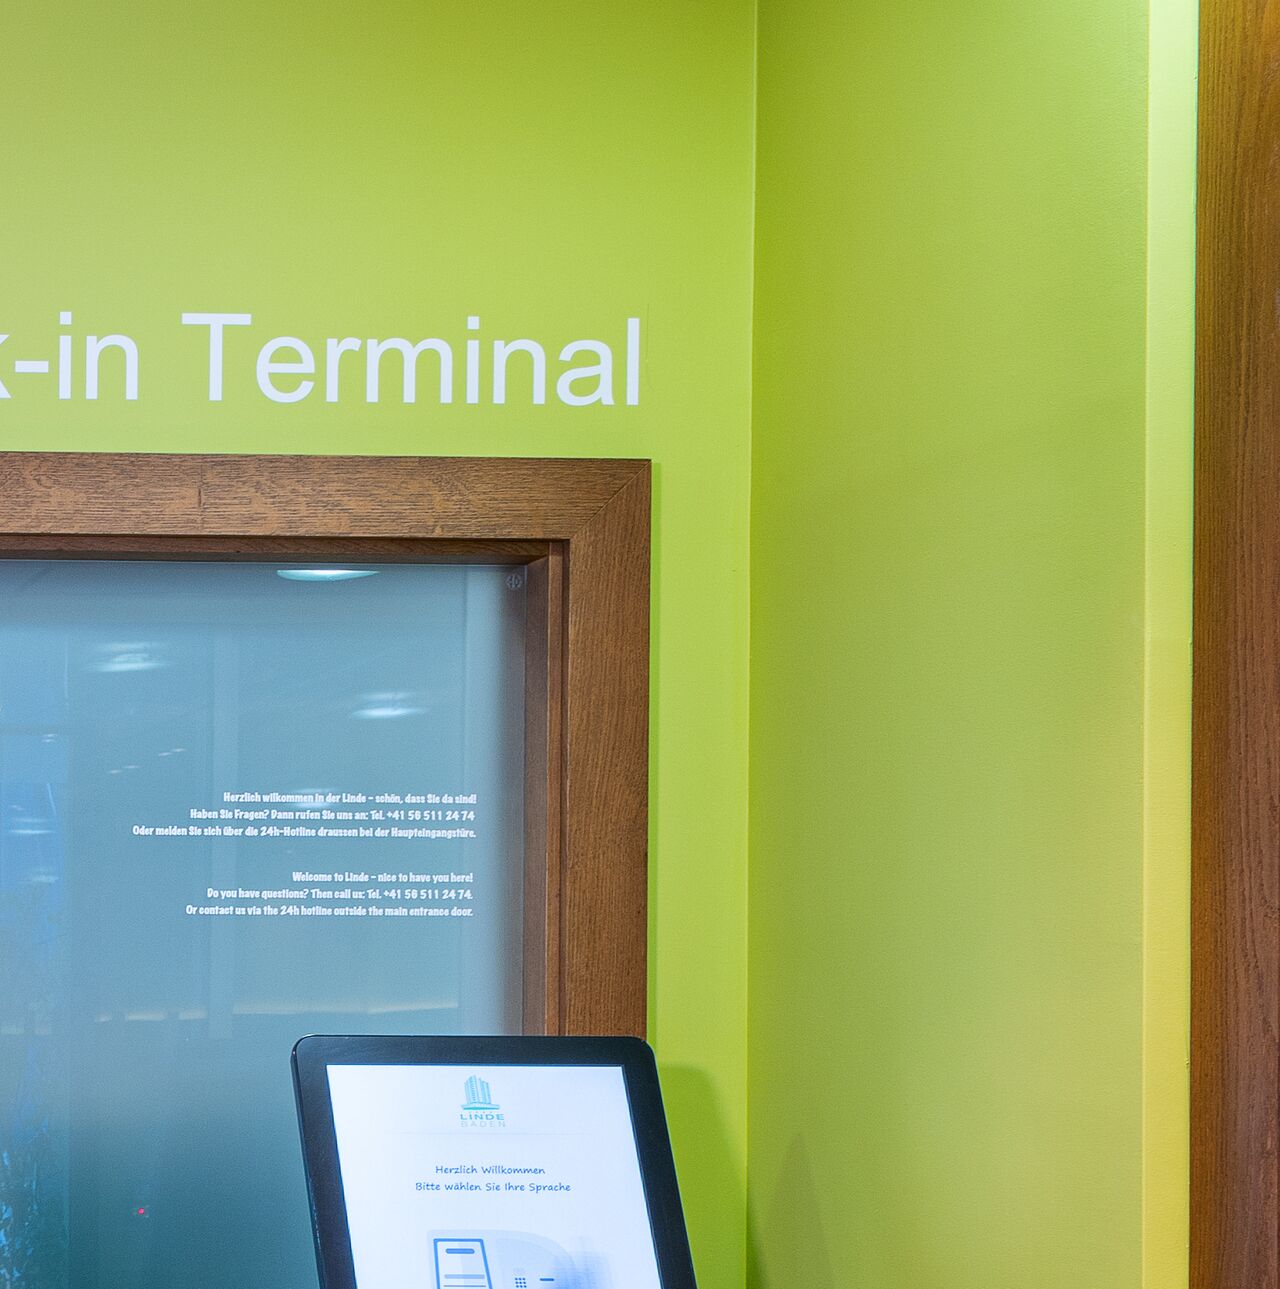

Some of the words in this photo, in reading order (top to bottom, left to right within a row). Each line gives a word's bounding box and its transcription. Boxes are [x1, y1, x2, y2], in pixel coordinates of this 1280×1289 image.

[181, 312, 640, 405] Terminal
[223, 792, 261, 802] Herzlich
[315, 793, 324, 803] in
[326, 793, 341, 803] der
[342, 793, 366, 803] Linde
[375, 793, 403, 804] schön,
[405, 794, 425, 804] dass
[427, 794, 440, 804] Sie
[442, 794, 454, 804] da
[455, 794, 477, 804] sind!
[190, 809, 218, 819] Haben
[220, 809, 233, 819] Sie
[234, 809, 269, 821] Fragen?
[271, 809, 294, 819] Dann
[295, 810, 320, 820] rufen
[322, 810, 335, 820] Sie
[337, 811, 352, 820] uns
[354, 811, 368, 820] an:
[370, 810, 385, 820] Tel.
[387, 811, 404, 820] +41
[424, 811, 442, 820] 511
[446, 811, 459, 820] 24
[462, 811, 475, 821] 74
[133, 826, 154, 836] Oder
[156, 826, 188, 836] melden
[189, 826, 202, 836] Sie
[204, 826, 221, 836] sich
[223, 826, 244, 836] über
[245, 826, 258, 836] die
[260, 826, 316, 837] 24h-Hotline
[318, 827, 358, 837] draussen
[359, 827, 373, 837] bei
[374, 827, 390, 837] der
[391, 827, 476, 839] Haupteingangstüre.
[292, 872, 332, 882] Welcome
[334, 872, 343, 882] to
[345, 872, 369, 882] Linde
[378, 873, 397, 882] nice
[399, 873, 408, 882] to
[409, 873, 430, 882] have
[432, 874, 449, 884] you
[450, 873, 473, 882] here!
[207, 888, 218, 898] Do
[220, 890, 237, 899] you
[238, 888, 259, 898] have
[261, 889, 309, 900] questions?
[311, 889, 333, 899] Then
[334, 889, 351, 899] call
[367, 889, 381, 899] Tel.
[383, 889, 401, 899] +41
[420, 889, 439, 899] 511
[442, 889, 456, 899] 24
[458, 889, 473, 899] 74.
[186, 905, 197, 915] Or
[199, 905, 233, 915] contact
[235, 906, 245, 915] us
[247, 905, 261, 915] via
[263, 905, 278, 915] the
[280, 905, 300, 915] 24h
[301, 905, 332, 916] hotline
[334, 906, 367, 916] outside
[368, 906, 384, 916] the
[385, 906, 408, 916] main
[409, 906, 449, 916] entrance
[451, 906, 473, 916] door.
[435, 1165, 478, 1174] Herzlich
[481, 1166, 546, 1175] Willkommen
[415, 1182, 441, 1191] Bitte
[444, 1182, 482, 1191] wählen
[485, 1182, 500, 1191] Sie
[505, 1182, 525, 1191] Ihre
[529, 1182, 571, 1194] Sprache
